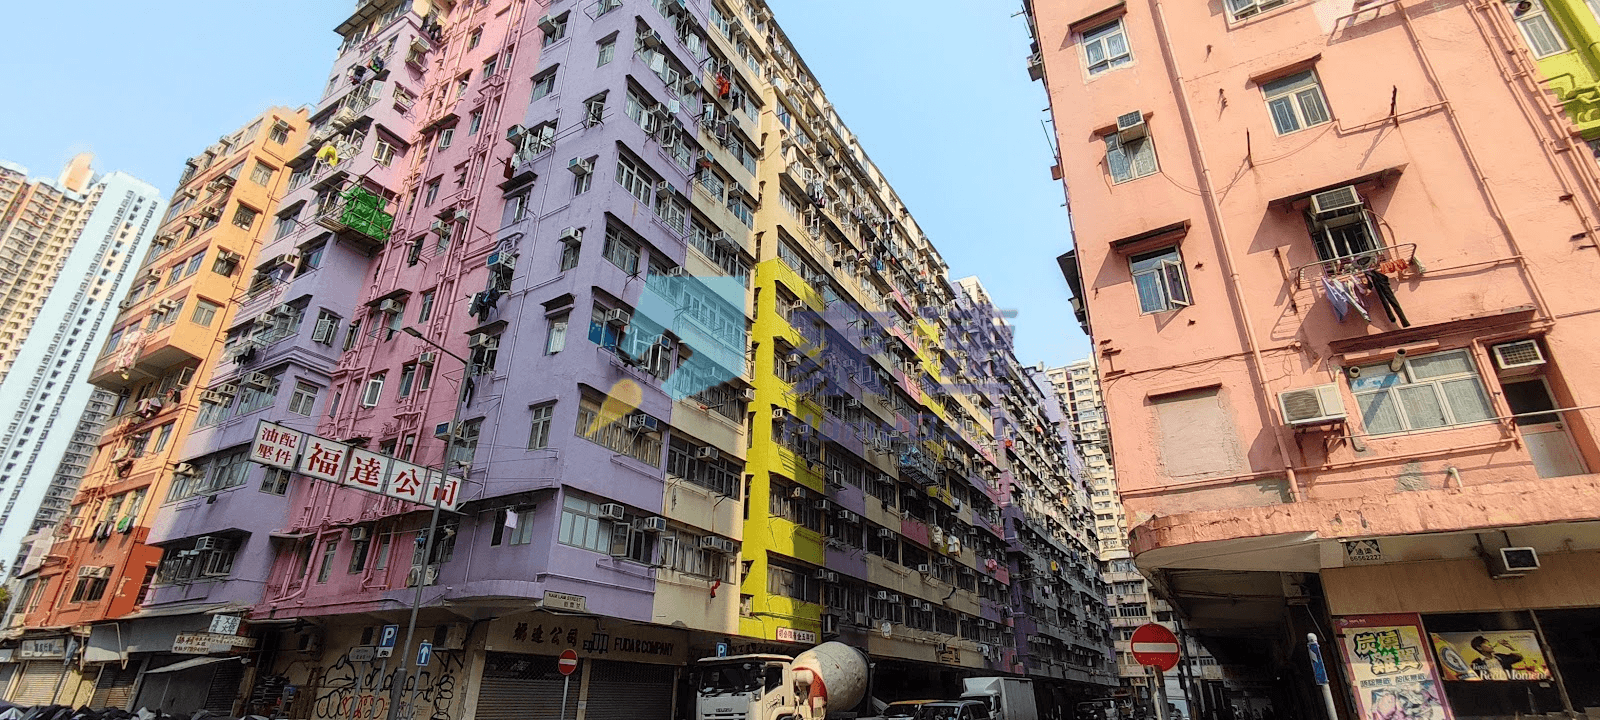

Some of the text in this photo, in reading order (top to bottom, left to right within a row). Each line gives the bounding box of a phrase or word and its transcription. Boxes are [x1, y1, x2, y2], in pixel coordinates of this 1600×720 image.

[307, 442, 458, 507] 福達公司
[382, 627, 395, 646] P
[717, 644, 725, 657] P
[1505, 669, 1548, 680] Moment
